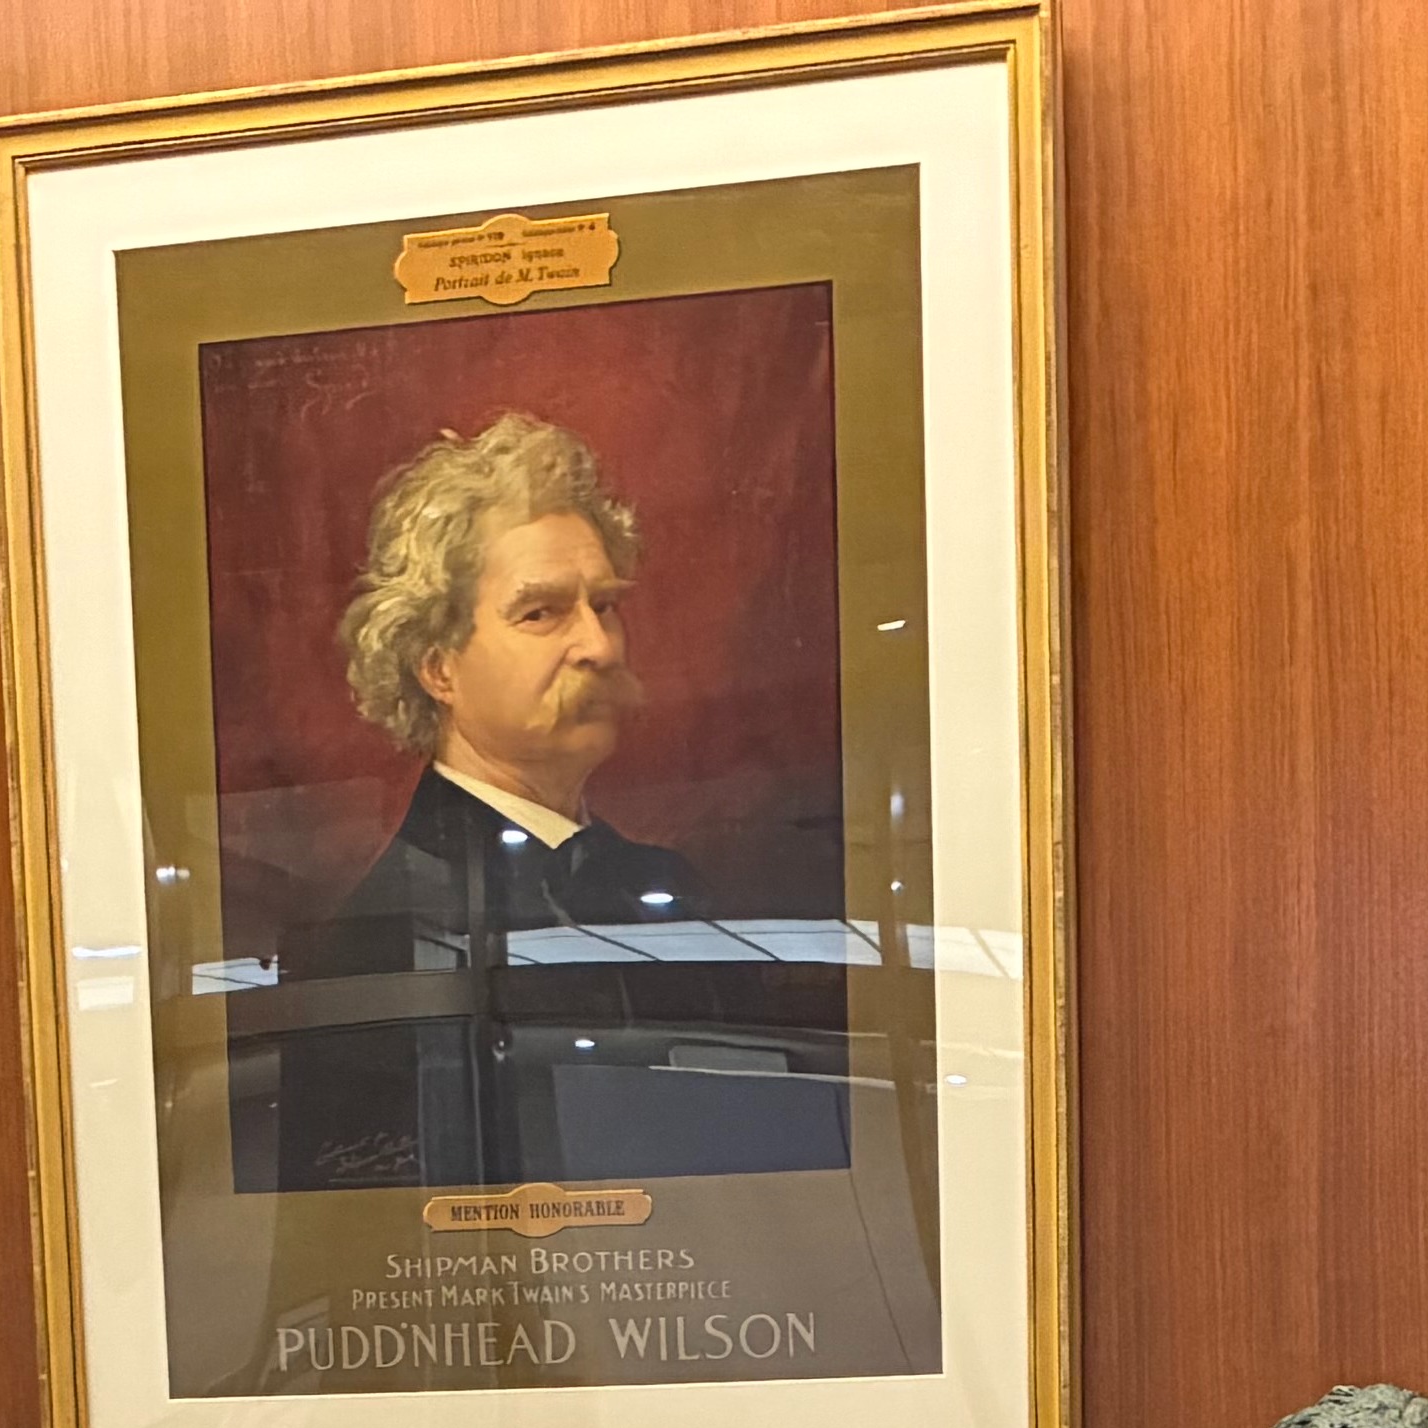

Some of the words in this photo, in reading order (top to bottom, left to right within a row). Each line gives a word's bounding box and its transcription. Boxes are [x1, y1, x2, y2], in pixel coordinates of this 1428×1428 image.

[434, 274, 490, 292] Portrait
[495, 271, 514, 285] de
[450, 1203, 521, 1222] MENTION
[529, 1199, 625, 1220] HONORABLE
[530, 1247, 696, 1275] BROTHERS
[352, 1288, 435, 1311] PRESENT
[440, 1285, 506, 1307] MARK
[600, 1279, 733, 1302] MASTERPIECE
[607, 1311, 816, 1363] WILSON
